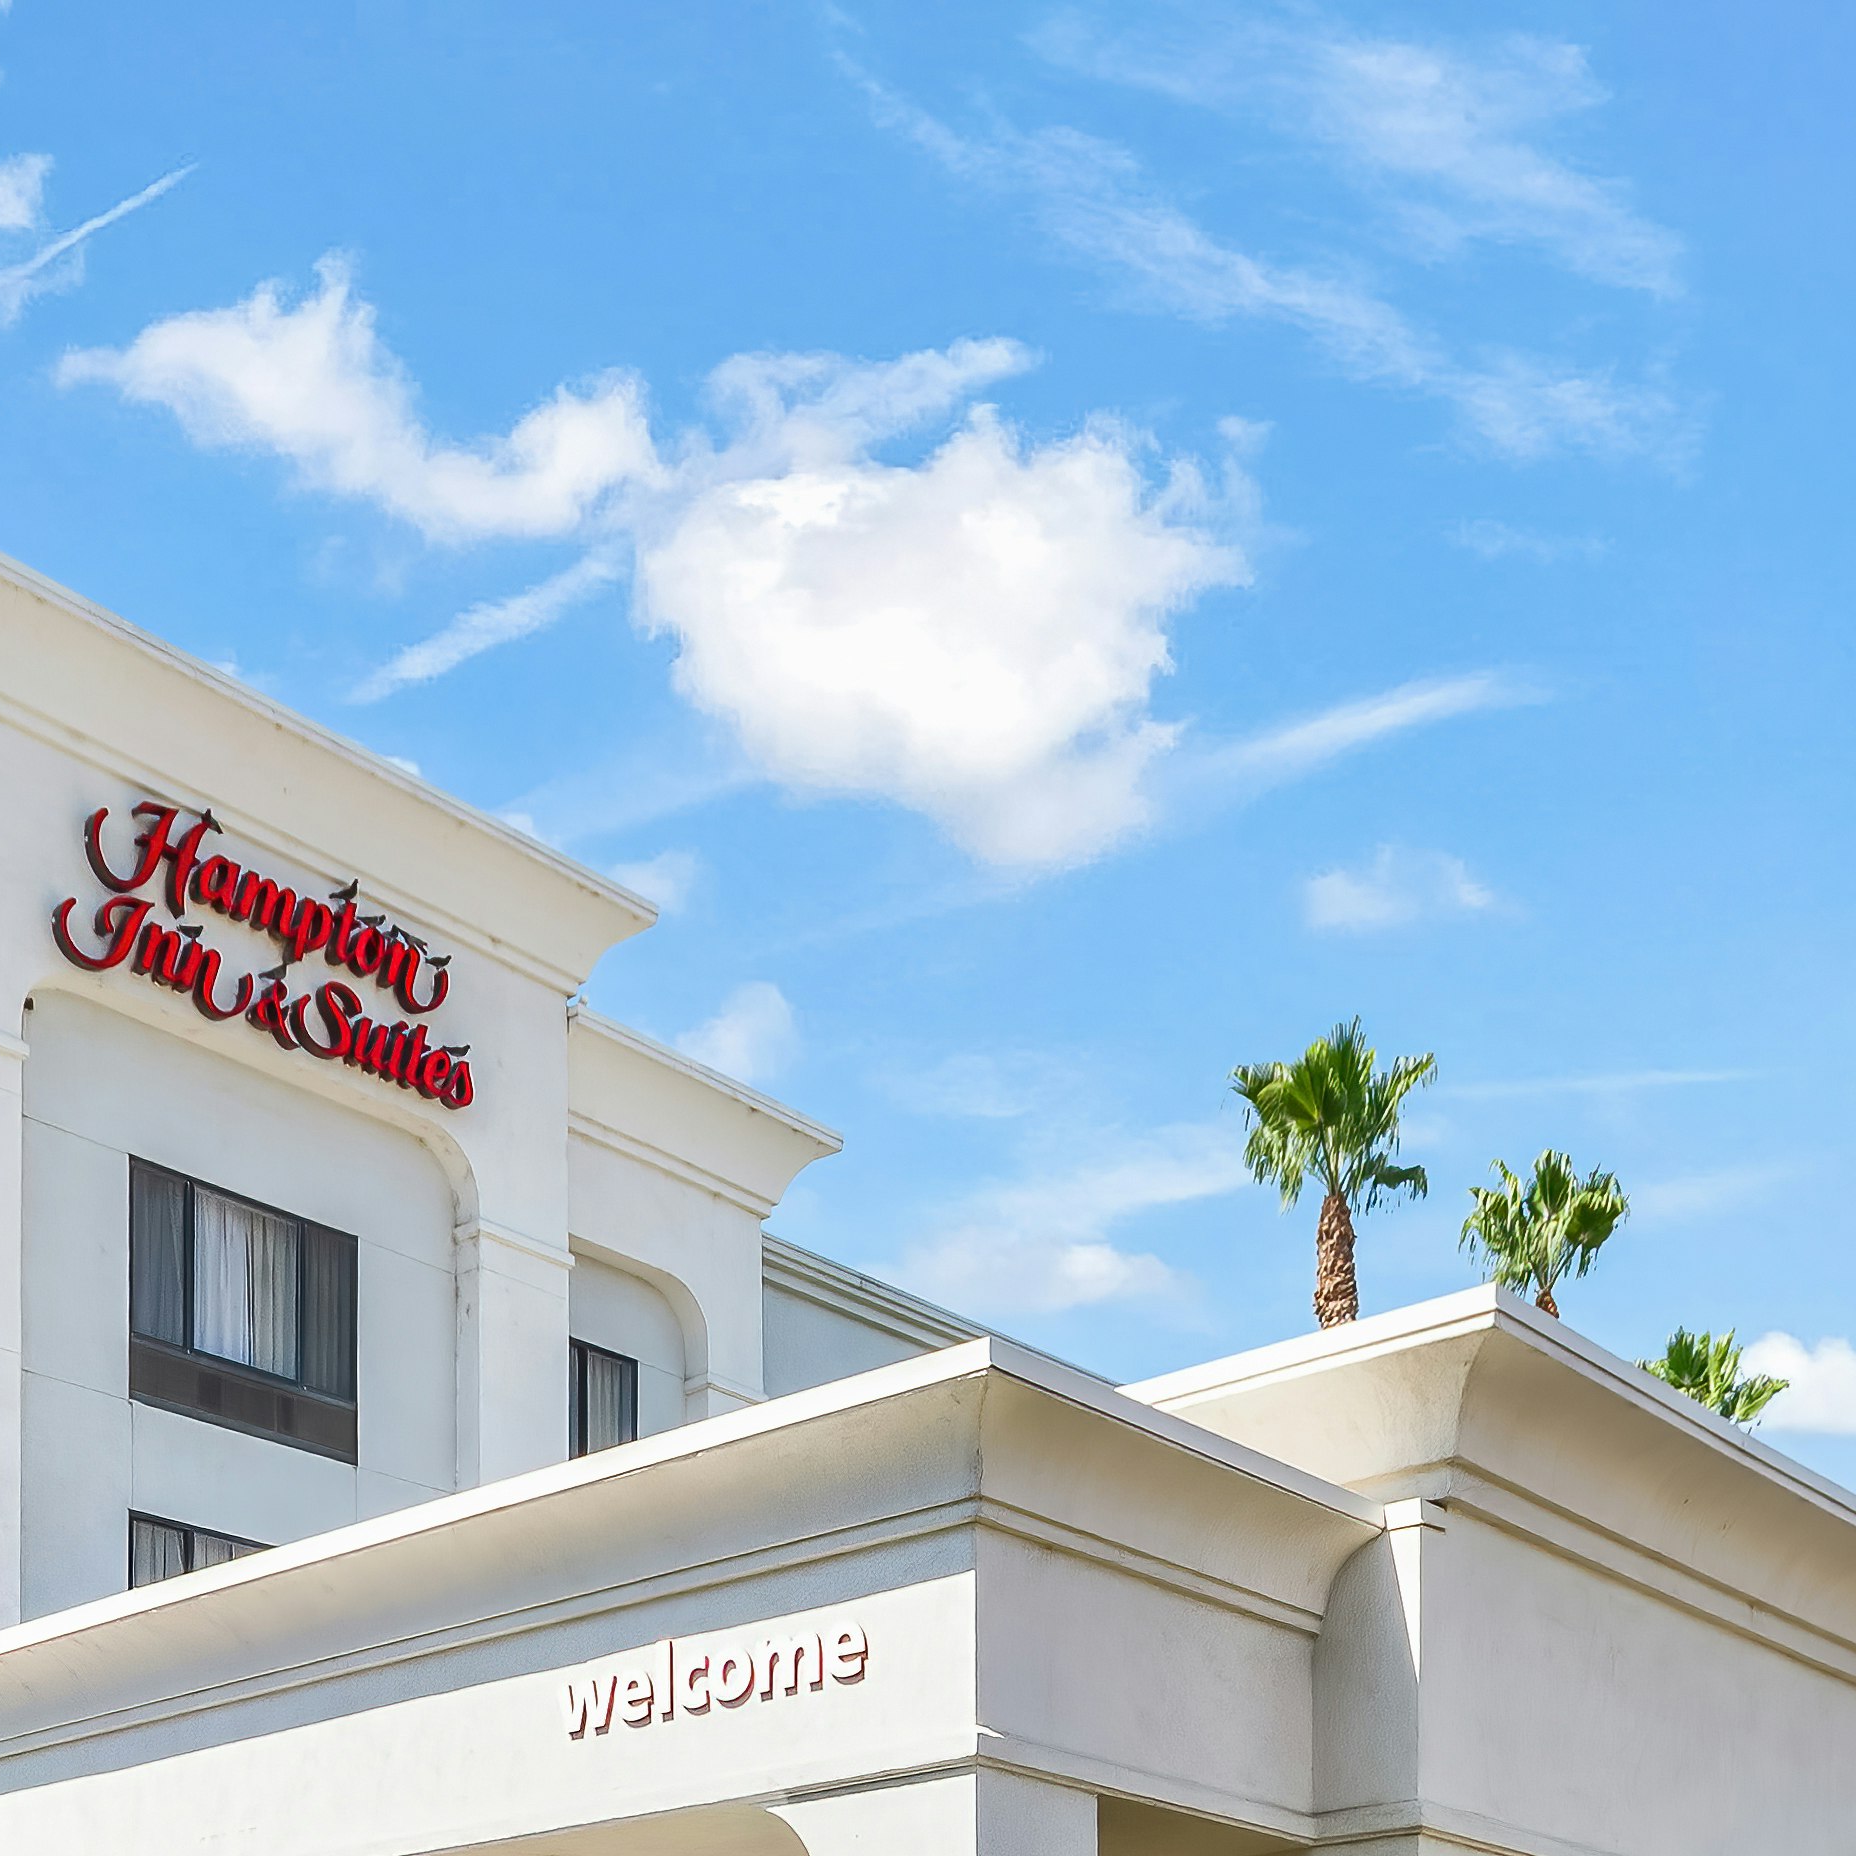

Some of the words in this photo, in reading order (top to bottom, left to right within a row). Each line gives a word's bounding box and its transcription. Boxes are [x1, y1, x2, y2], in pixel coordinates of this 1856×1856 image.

[51, 896, 255, 1021] Inn
[245, 978, 300, 1050] &
[290, 980, 474, 1110] Suites
[84, 801, 449, 1014] Hampton
[557, 1621, 869, 1740] welcome
